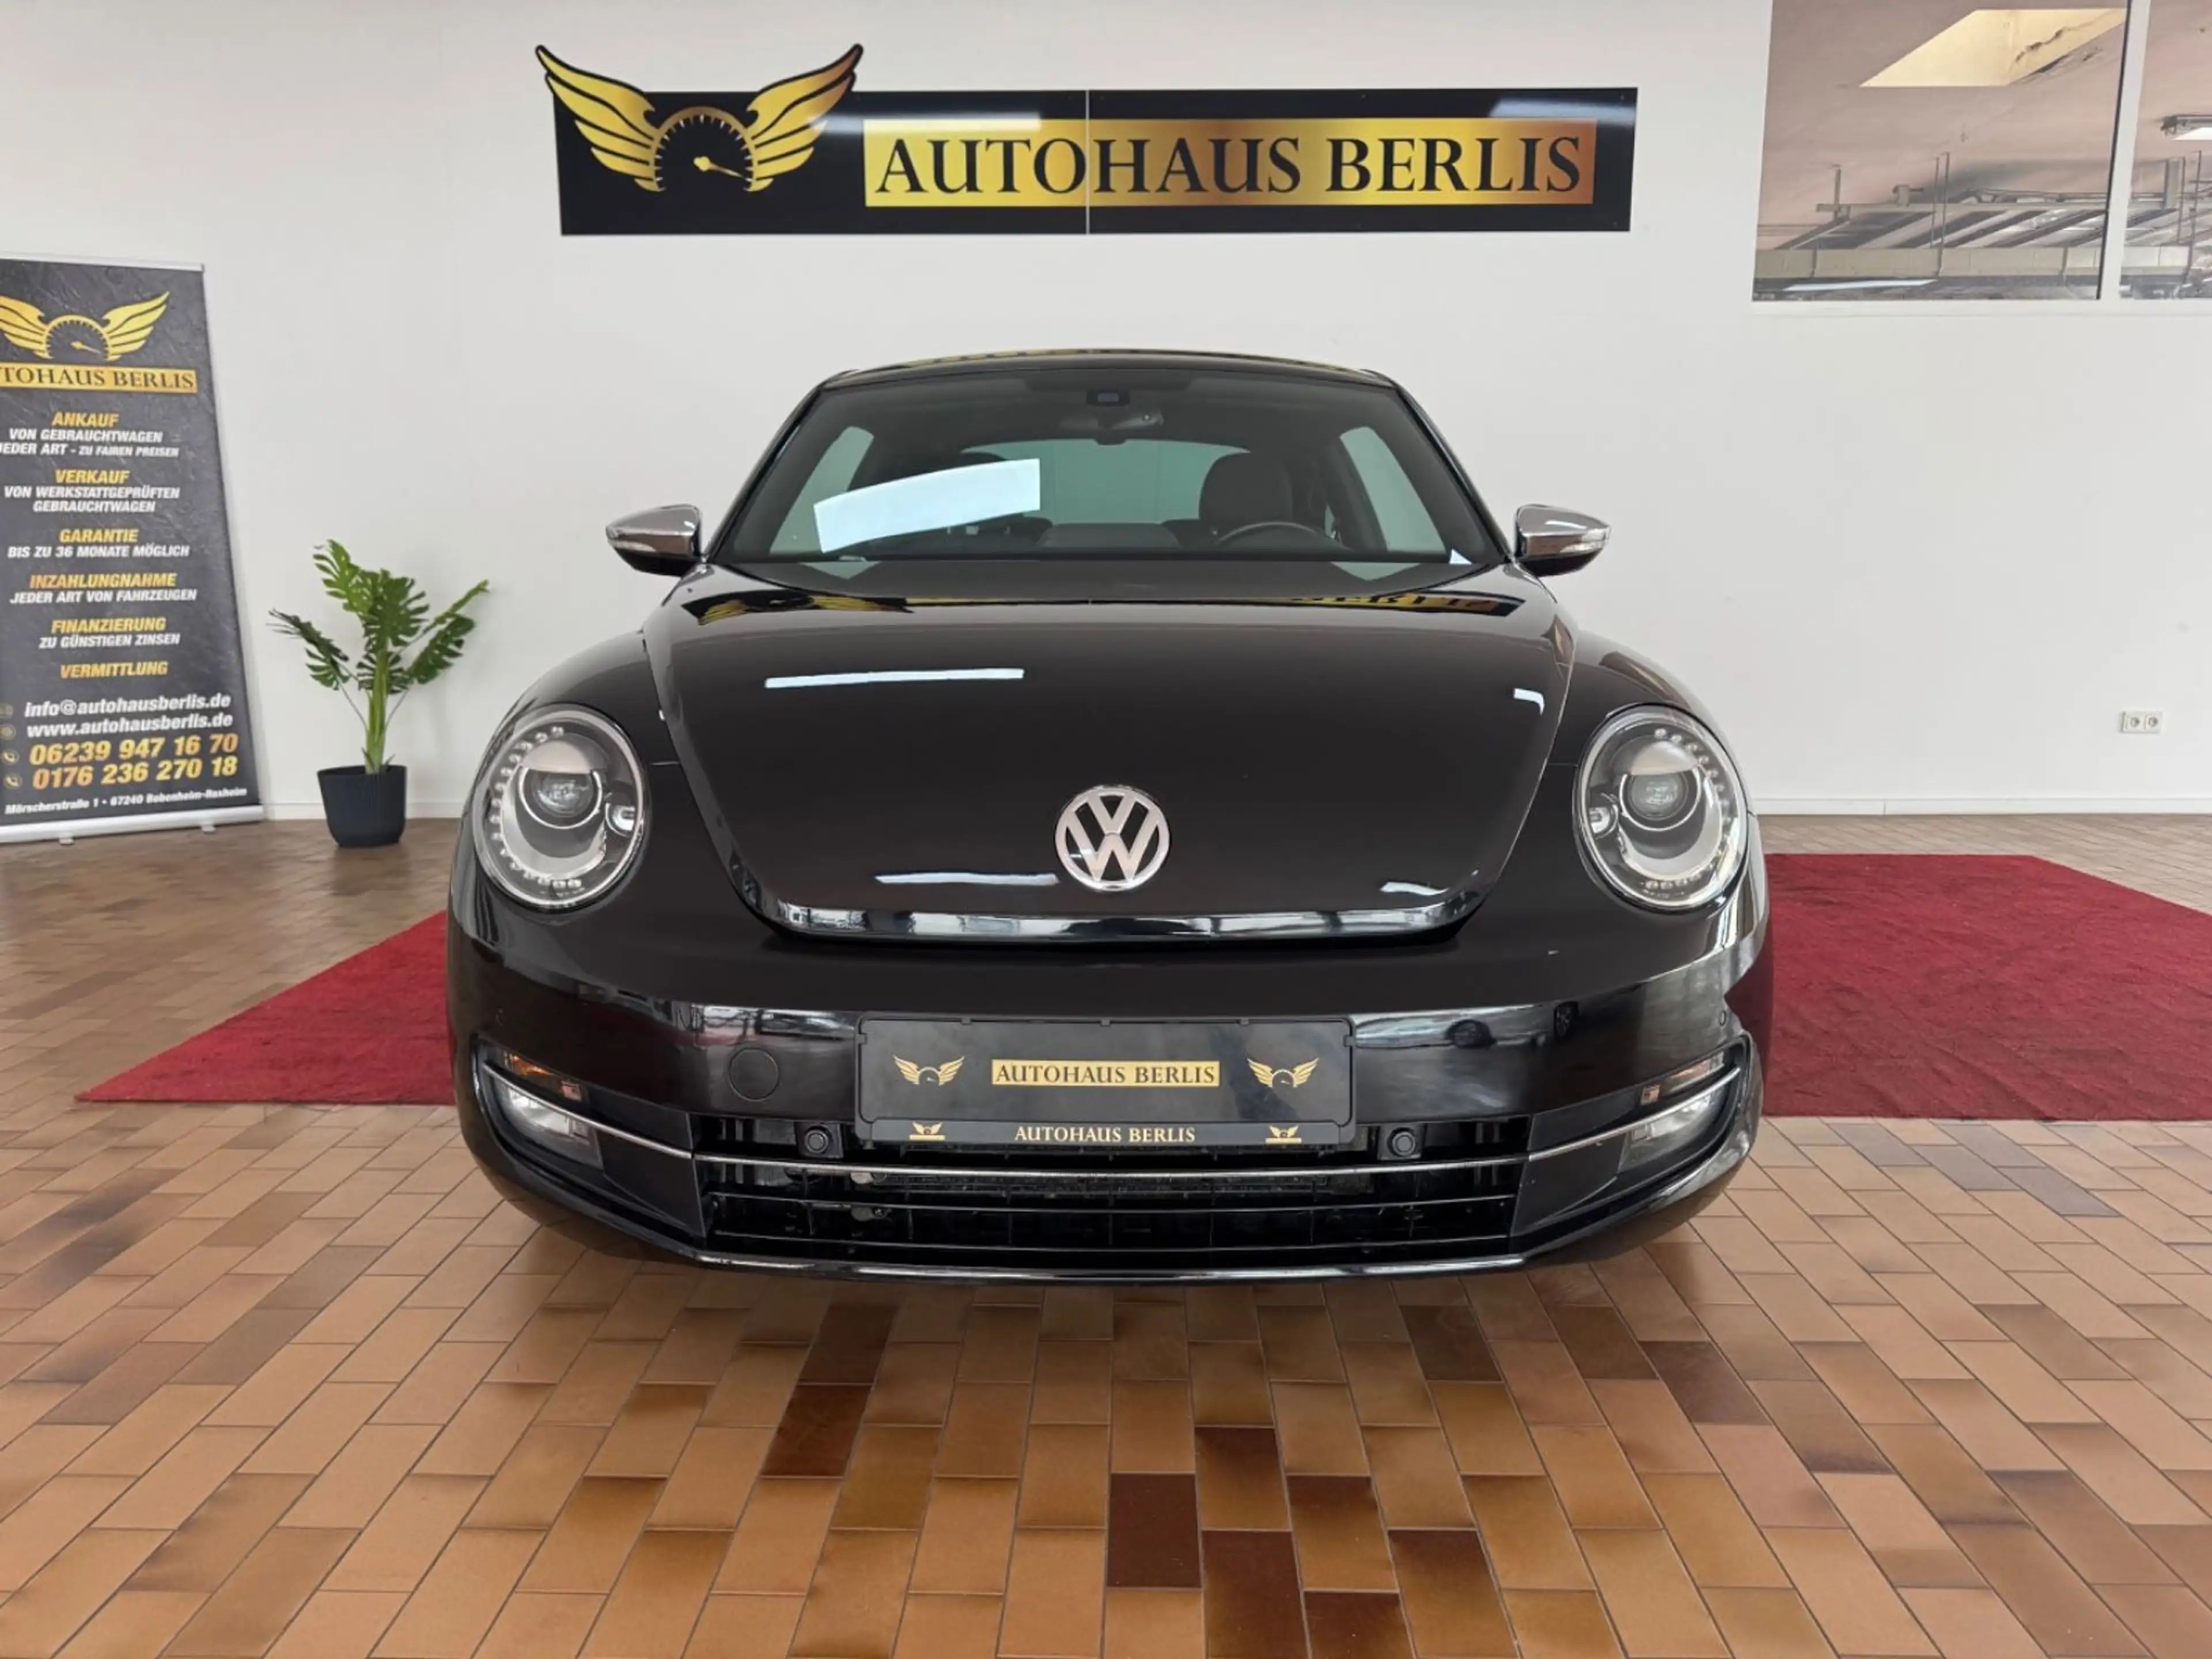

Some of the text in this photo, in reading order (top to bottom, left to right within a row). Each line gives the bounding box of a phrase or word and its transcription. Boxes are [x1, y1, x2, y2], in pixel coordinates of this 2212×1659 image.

[875, 137, 1581, 194] AUTOHAUS BERLIS
[113, 370, 195, 389] BERLIS
[51, 411, 120, 427] ANKAUF
[9, 428, 163, 443] VON GEBRAUCHTWAGEN
[40, 442, 69, 456] ART
[78, 446, 93, 456] ZU
[135, 446, 179, 457] PREISEN
[55, 469, 131, 484] VERKAUF
[3, 484, 180, 499] VON WERKSTATTGEPRÜFTEN
[33, 500, 156, 512] GEBRAUCHTWAGEN
[59, 528, 139, 543] GARANTIE
[7, 542, 190, 558] BIS ZU 36 MONATE MÖGLICH
[29, 572, 177, 589] INZAHLUNGNAHME
[9, 588, 198, 604] JEDER ART VON FAHRZEUGEN
[51, 617, 167, 634] FINANZIERUNG
[39, 632, 180, 649] ZU GÜNSTIGEN ZINSEN
[60, 661, 169, 679] VERMITTLUNG
[24, 693, 232, 718] info@autohausberlis.de
[26, 713, 233, 738] www.autohausberlis.de
[29, 733, 238, 765] 06239 947 16 70
[32, 756, 238, 790] 0176 236 270 18
[995, 1064, 1215, 1084] AUTOHAUS BERLIS
[1014, 1125, 1196, 1143] AUTOHAUS BERLIS
